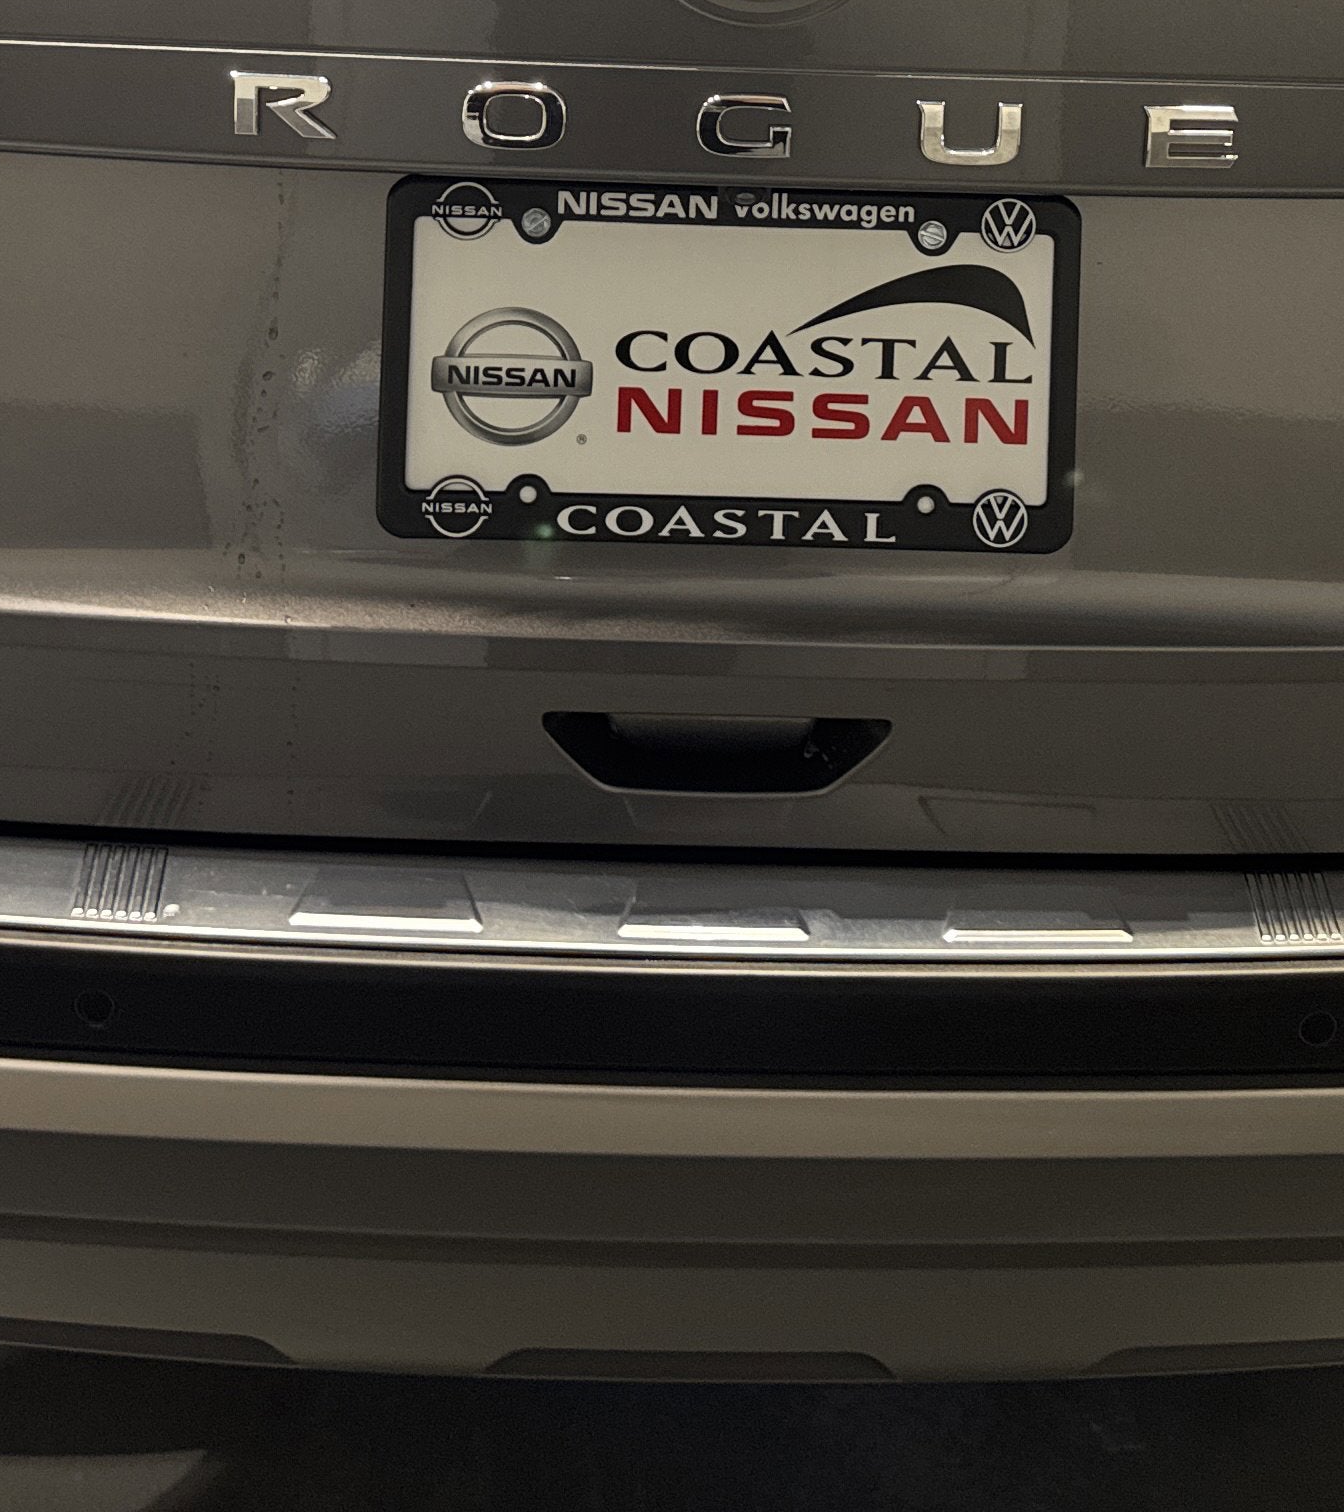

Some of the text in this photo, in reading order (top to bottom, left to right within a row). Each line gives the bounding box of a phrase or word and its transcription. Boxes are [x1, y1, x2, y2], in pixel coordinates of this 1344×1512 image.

[230, 70, 1241, 170] ROGUE
[431, 201, 503, 219] NISSAN
[557, 190, 718, 221] NISSAN
[614, 329, 1034, 384] COASTAL
[447, 364, 577, 389] NISSAN
[616, 386, 1029, 445] NISSAN
[421, 498, 493, 516] NISSAN
[556, 505, 896, 543] COASTAL
